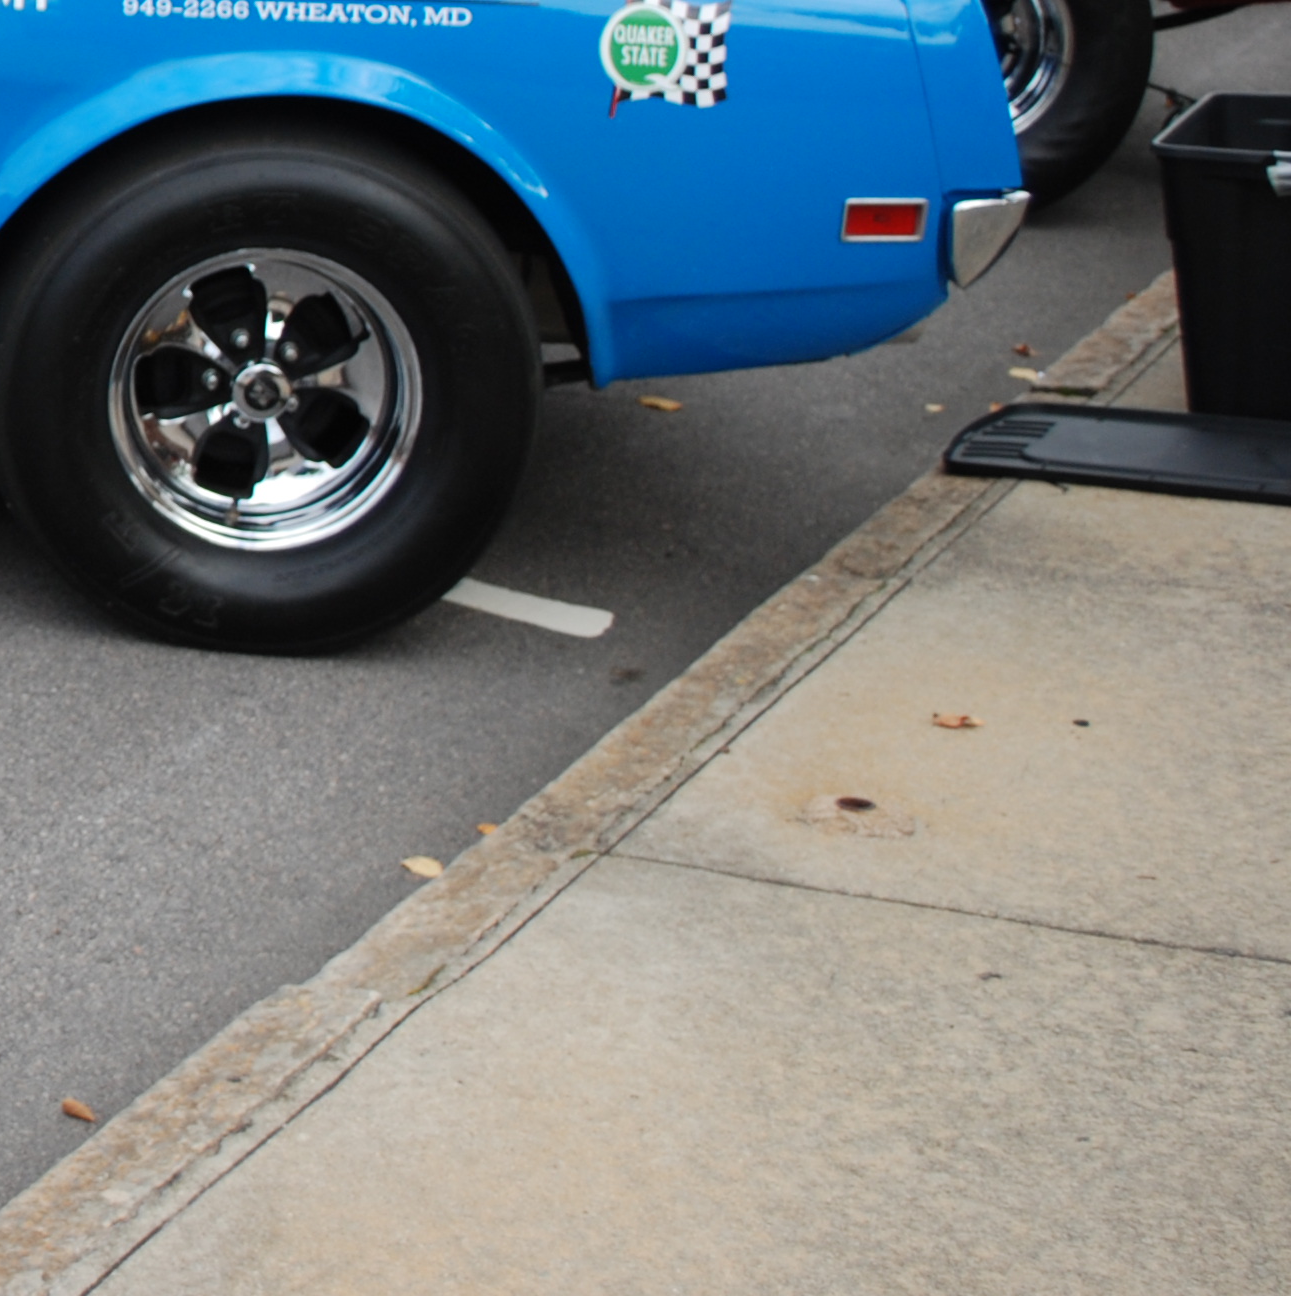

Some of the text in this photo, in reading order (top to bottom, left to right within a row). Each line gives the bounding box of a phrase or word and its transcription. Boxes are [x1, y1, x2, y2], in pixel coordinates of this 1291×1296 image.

[256, 0, 418, 29] WHEATON,
[422, 5, 473, 28] MD
[613, 22, 676, 47] QUAKER
[620, 44, 669, 68] STATE
